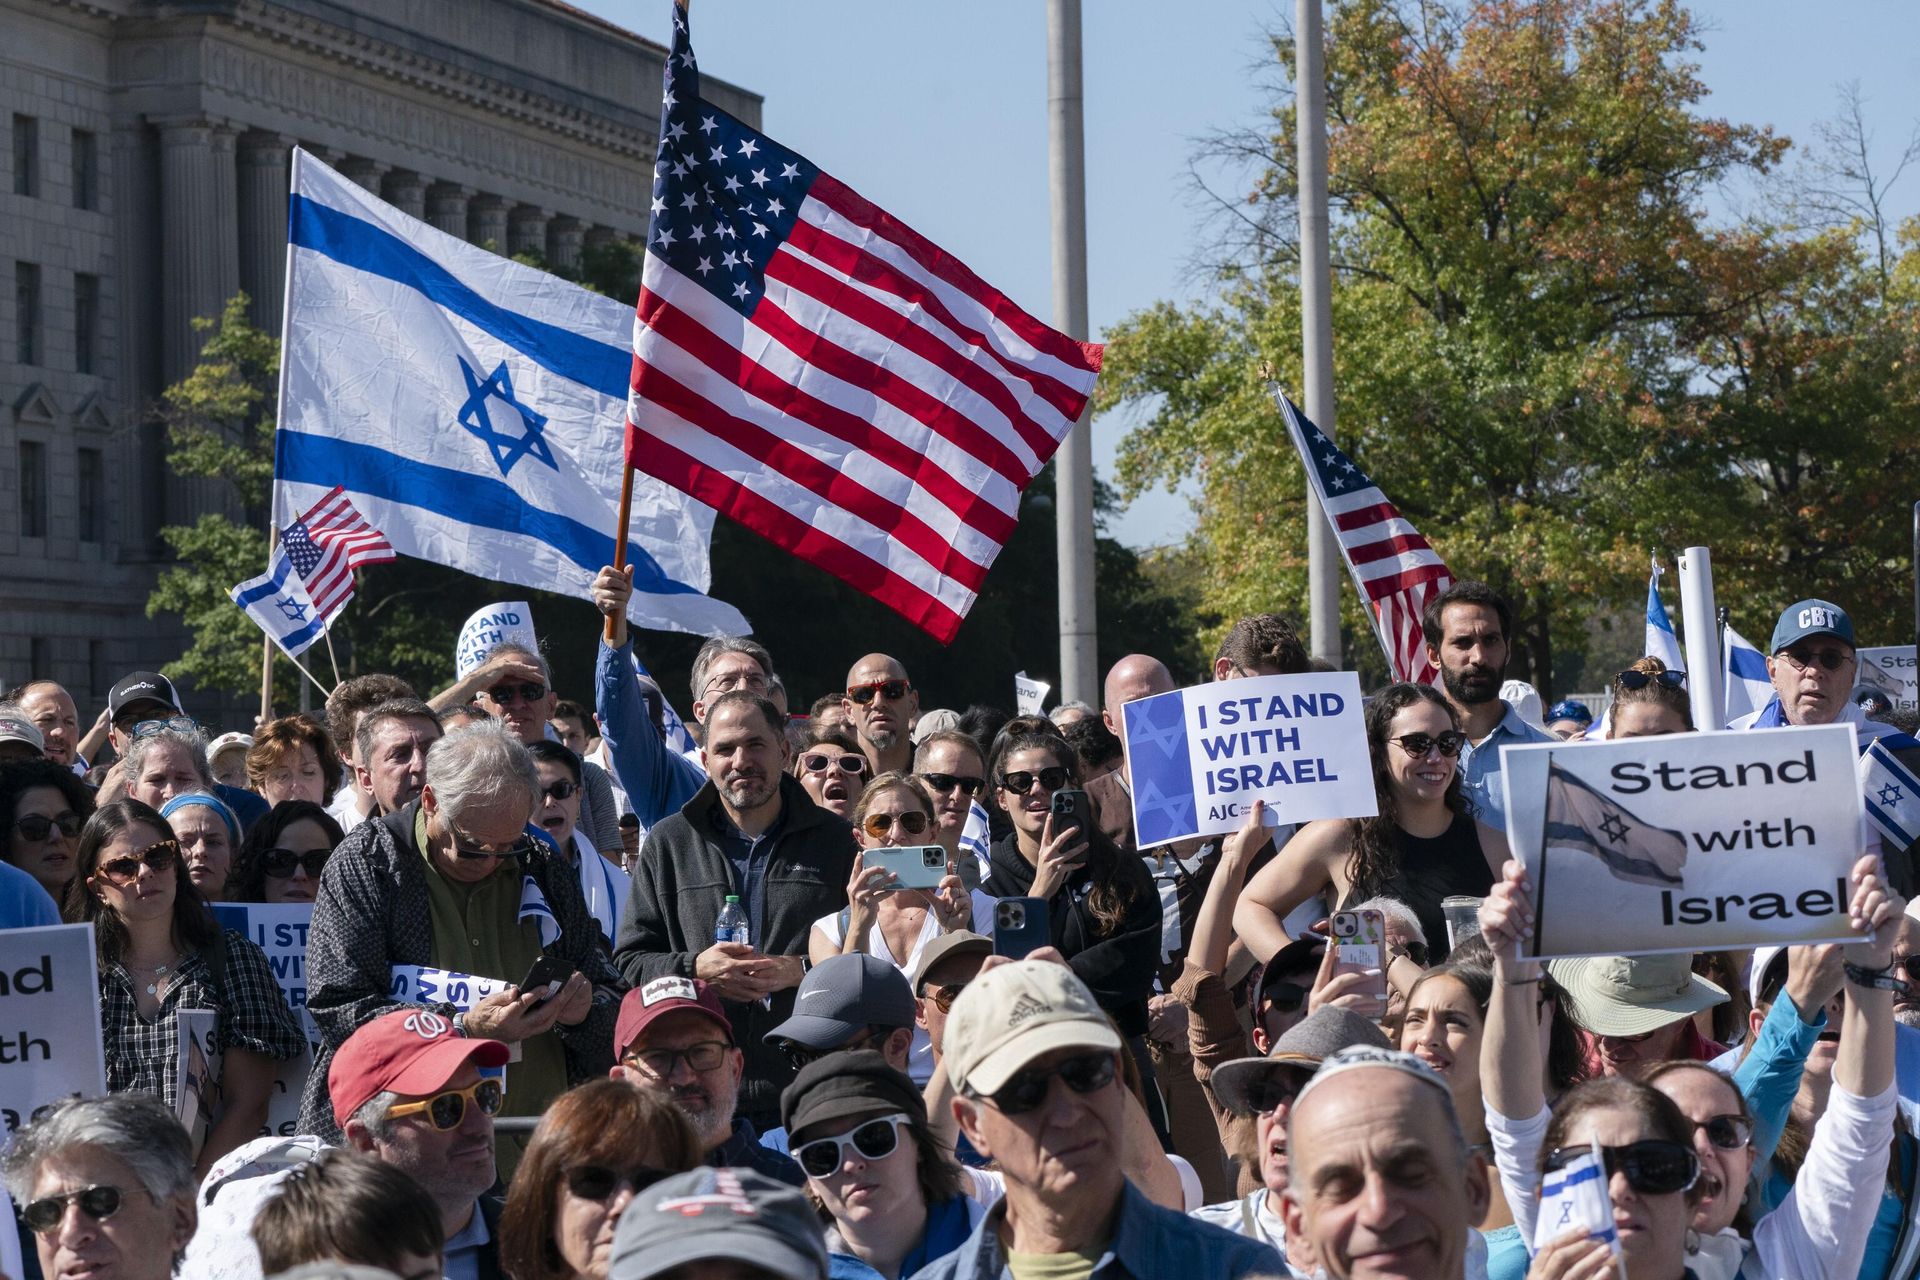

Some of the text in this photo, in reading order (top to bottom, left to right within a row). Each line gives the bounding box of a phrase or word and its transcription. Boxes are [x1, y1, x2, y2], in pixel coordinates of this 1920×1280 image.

[1798, 606, 1835, 629] CBT
[458, 630, 504, 660] WITH
[460, 649, 487, 671] ISR
[1881, 656, 1917, 668] Sta
[1017, 687, 1038, 699] and
[1197, 692, 1345, 730] I STAND
[1200, 727, 1301, 762] WITH
[1205, 758, 1339, 796] ISRAEL
[1610, 750, 1817, 795] Stand
[1208, 803, 1239, 821] AJC
[1692, 817, 1816, 853] with
[1660, 877, 1849, 926] Israel
[1008, 1005, 1054, 1027] adidas
